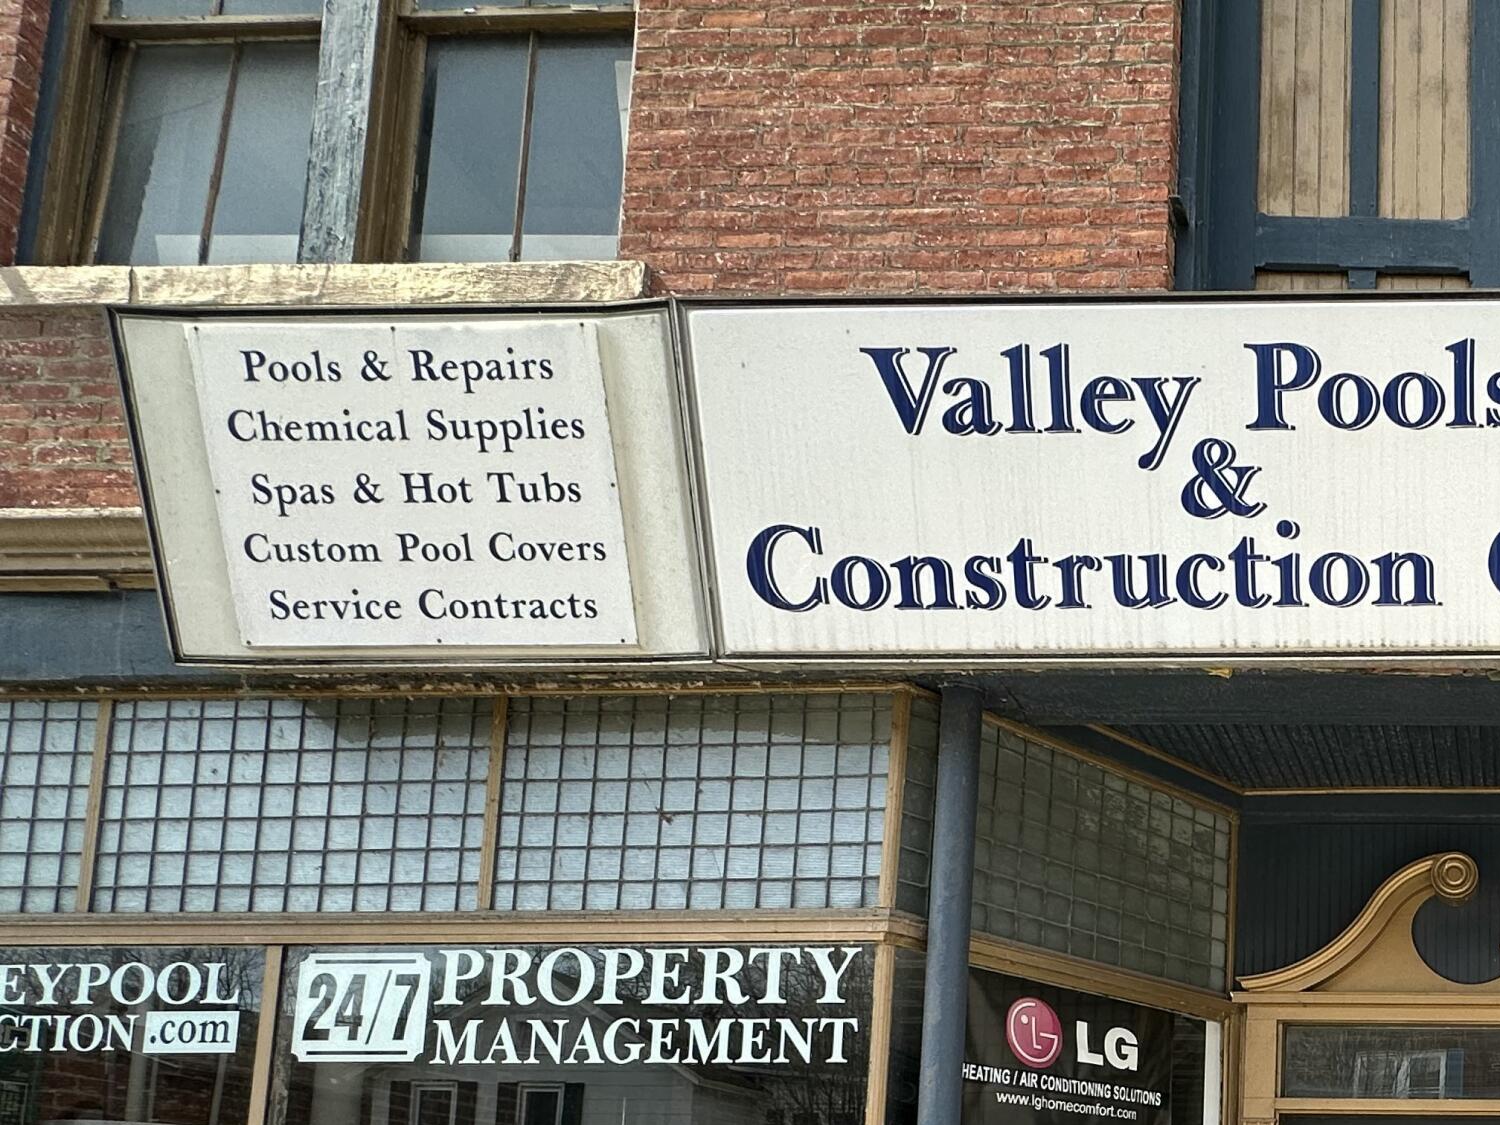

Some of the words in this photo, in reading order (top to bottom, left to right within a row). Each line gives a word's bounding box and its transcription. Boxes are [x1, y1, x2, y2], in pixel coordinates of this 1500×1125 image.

[240, 351, 341, 382] Pools
[361, 351, 390, 381] &
[409, 348, 553, 393] Repairs
[860, 342, 1201, 470] Valley
[228, 409, 409, 441] Chemical
[427, 408, 584, 452] Supplies
[252, 474, 334, 516] Spas
[354, 474, 383, 503] &
[400, 473, 472, 503] Hot
[487, 472, 581, 502] Tubs
[1181, 437, 1268, 519] &
[244, 534, 381, 562] Custom
[396, 533, 473, 561] Pool
[489, 532, 606, 561] Covers
[746, 519, 1444, 612] Construction
[270, 589, 401, 619] Service
[419, 589, 597, 619] Contracts
[0, 962, 239, 1005] EYPOOL
[437, 947, 863, 1006] PROPERTY
[302, 969, 421, 1045] 24/7
[150, 1020, 230, 1045] .com
[429, 1017, 859, 1066] MANAGEMENT
[1076, 1020, 1139, 1072] LG
[962, 1063, 1010, 1085] HEATING
[1019, 1071, 1037, 1089] AIR
[1041, 1075, 1111, 1099] CONDITIONING
[1113, 1085, 1162, 1106] SOLUTIONS
[996, 1091, 1137, 1121] www.lghomecomfort.com
